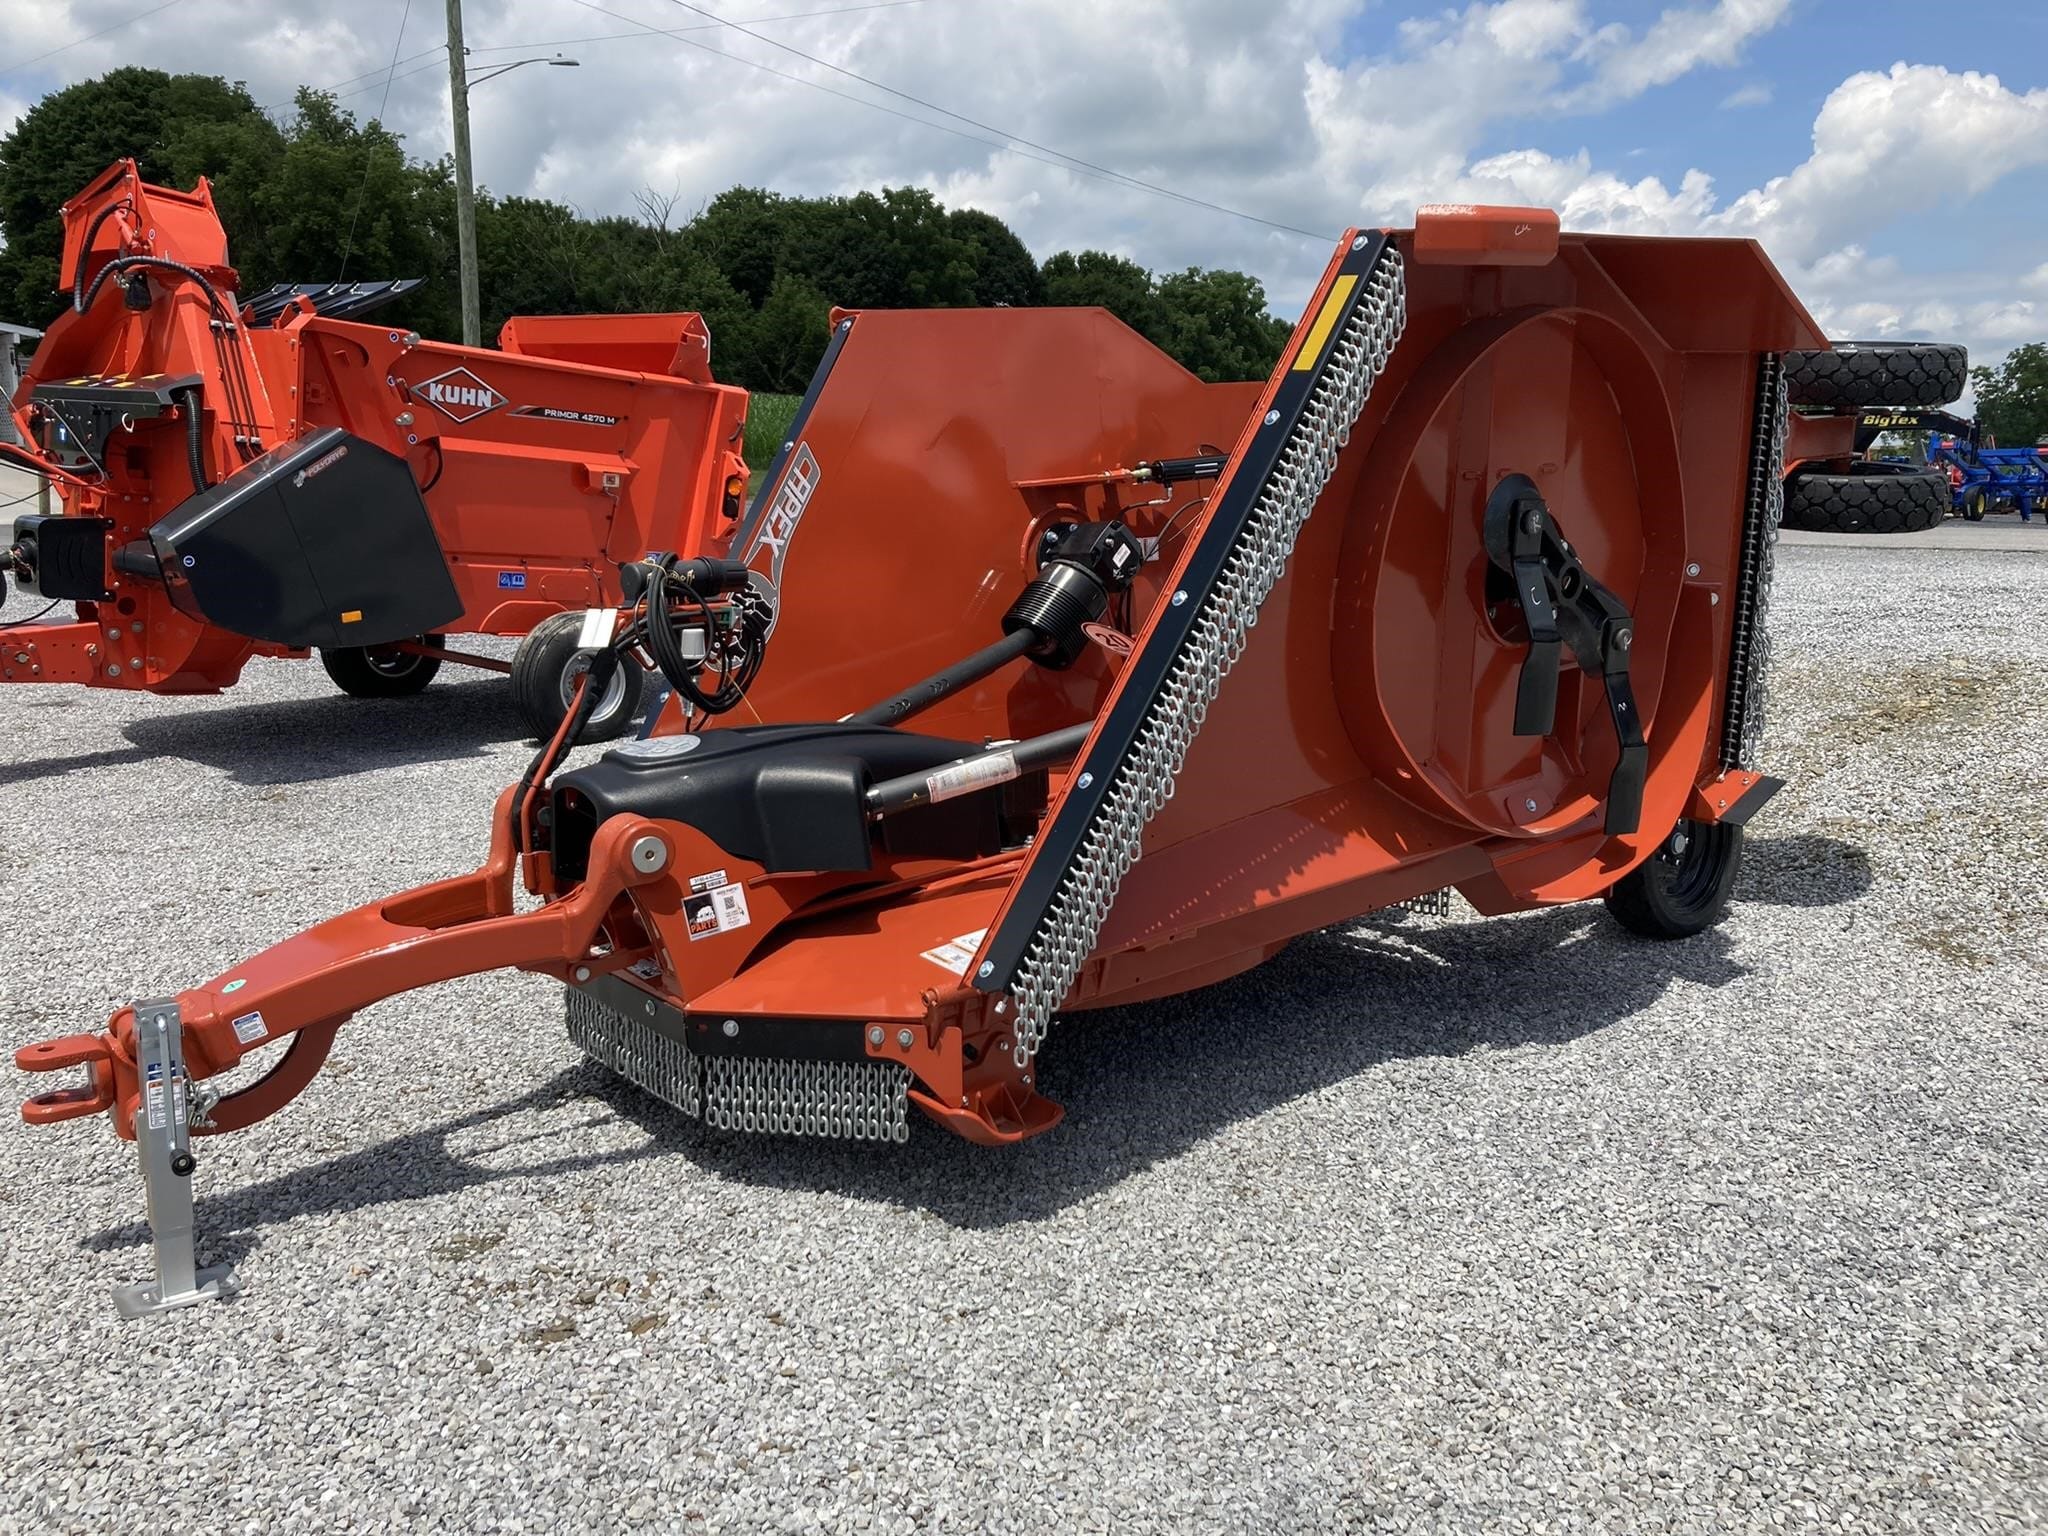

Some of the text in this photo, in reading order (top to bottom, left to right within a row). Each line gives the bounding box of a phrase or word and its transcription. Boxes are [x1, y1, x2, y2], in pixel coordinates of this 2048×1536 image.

[429, 383, 492, 408] KUHN
[544, 408, 615, 424] PRIMOR 4270 M
[1863, 414, 1920, 427] BigTex
[759, 465, 812, 559] APEX
[1094, 632, 1130, 649] 20
[690, 918, 718, 933] PARTS
